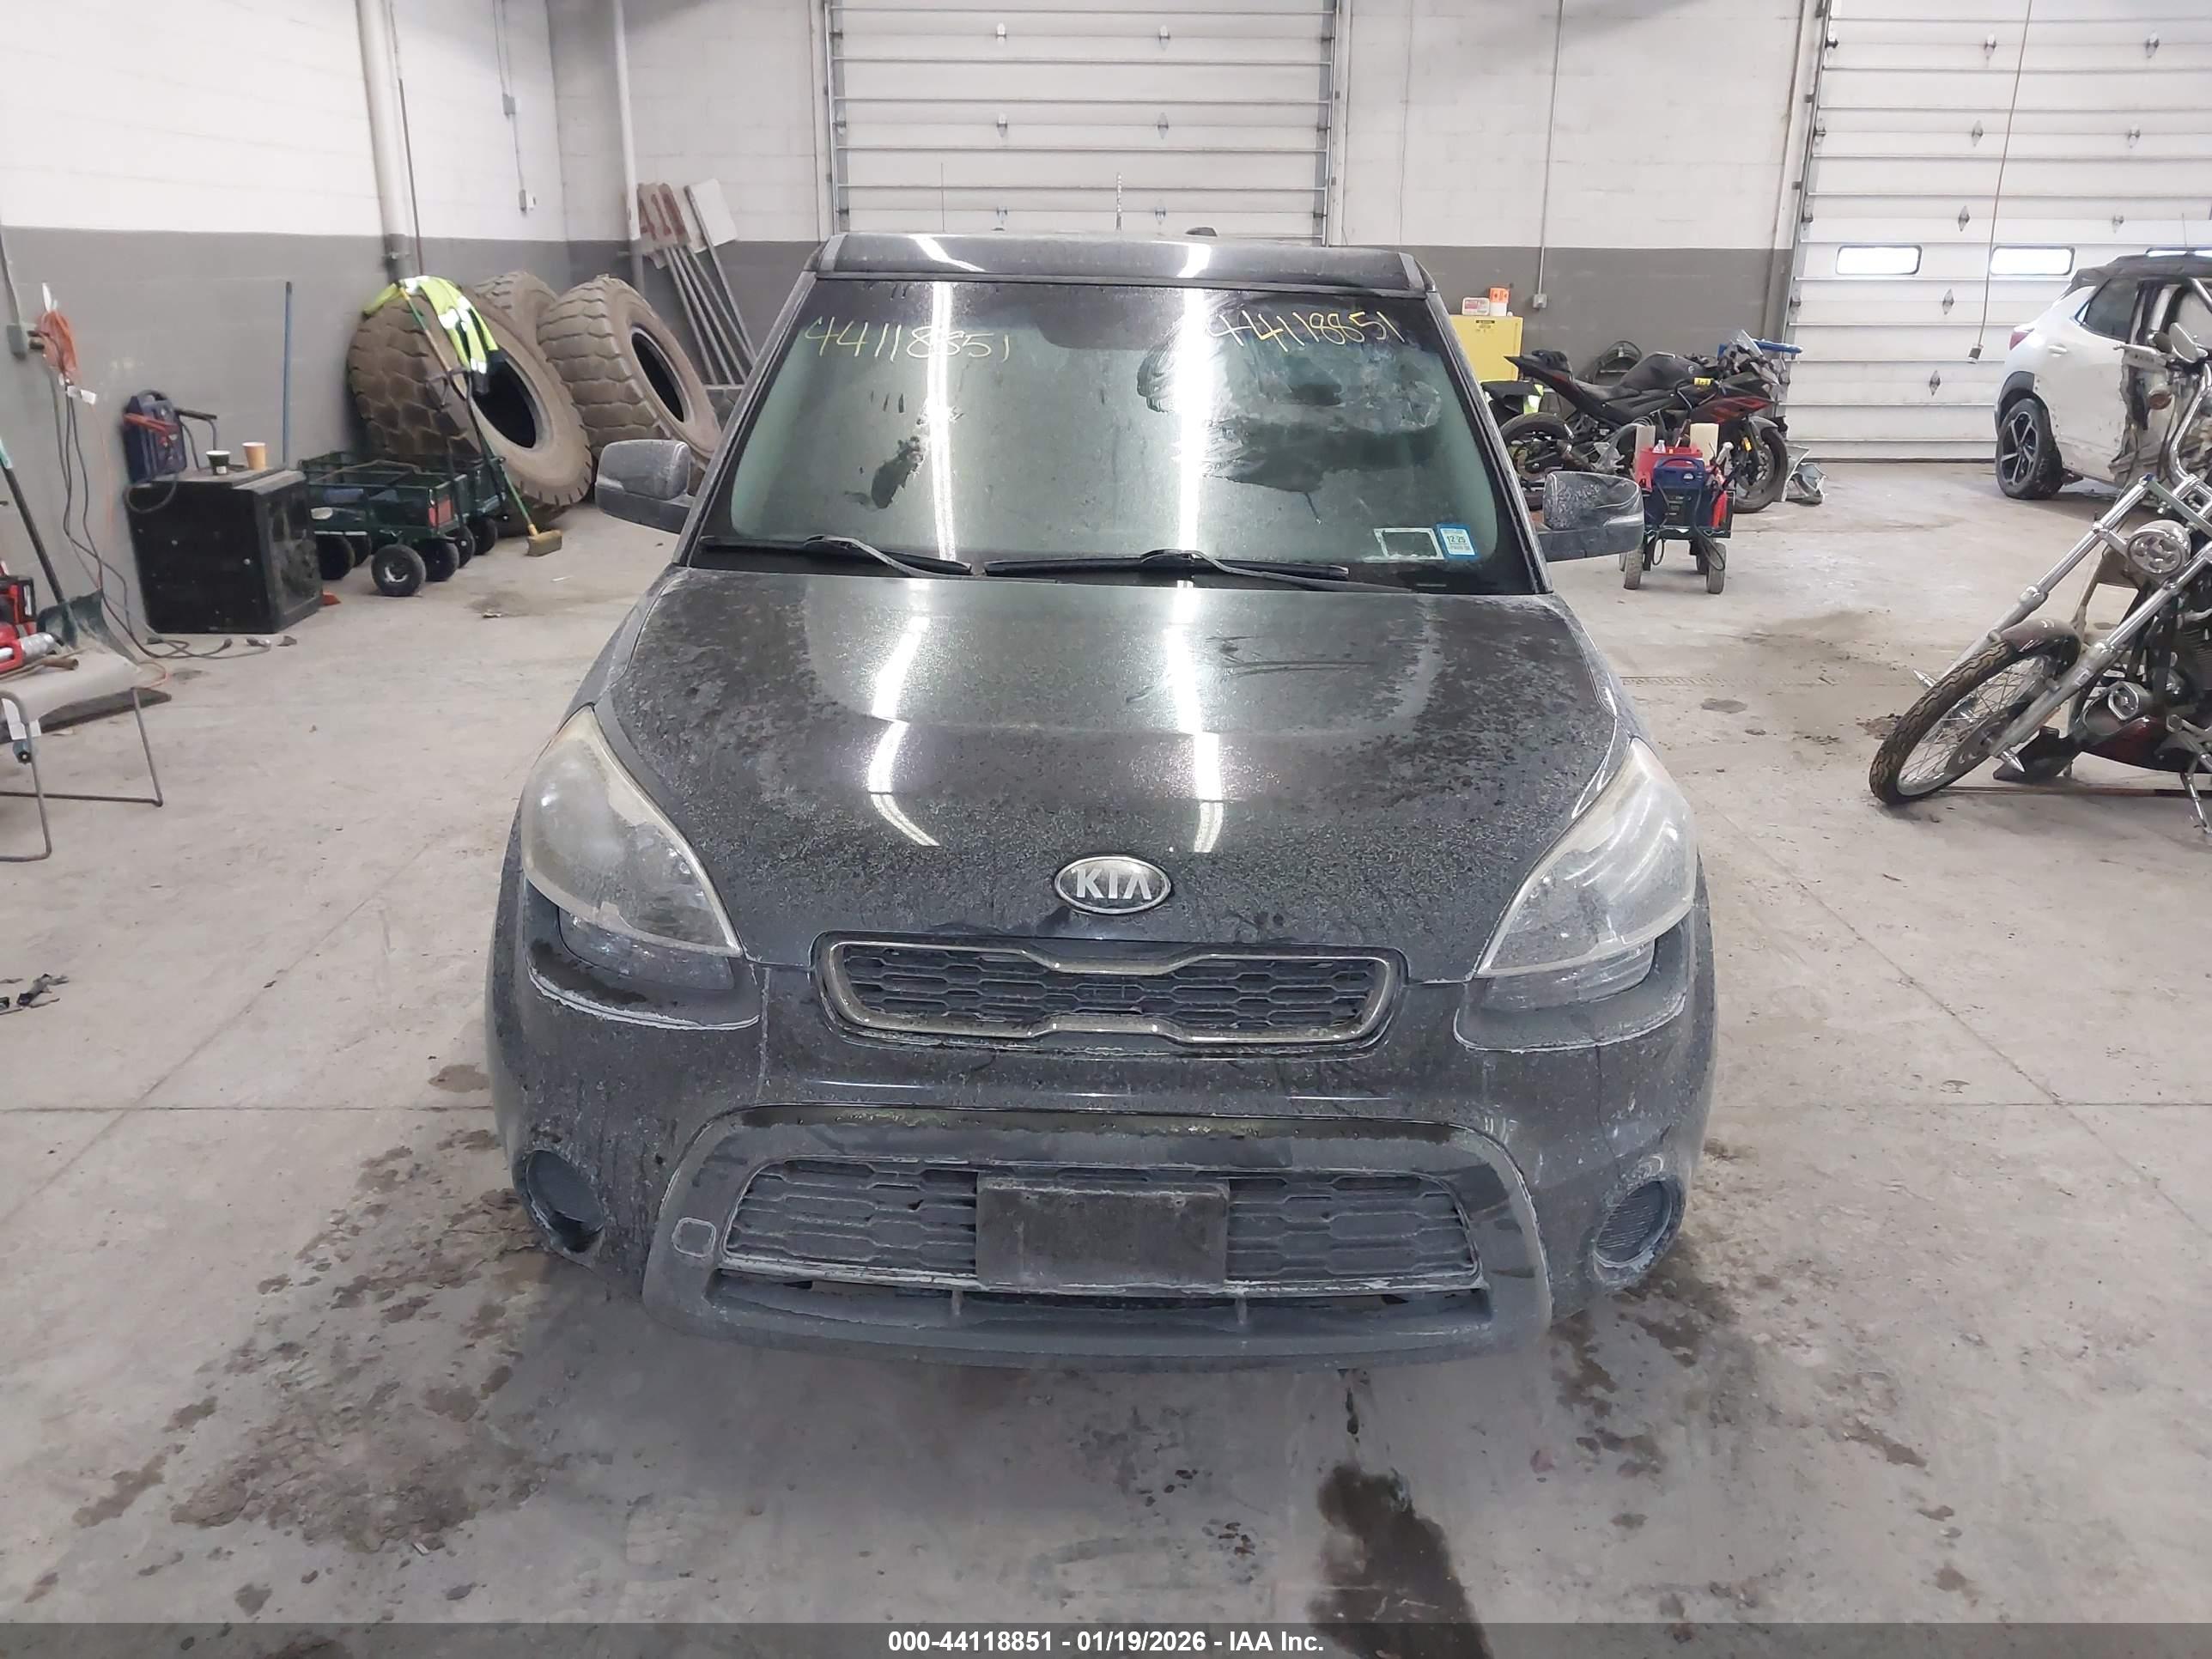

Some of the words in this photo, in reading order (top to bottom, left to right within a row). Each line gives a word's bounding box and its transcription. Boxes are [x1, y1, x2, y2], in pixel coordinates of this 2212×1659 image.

[804, 315, 1011, 362] 44118851
[1205, 309, 1406, 353] 44118851
[1075, 867, 1152, 901] KIA
